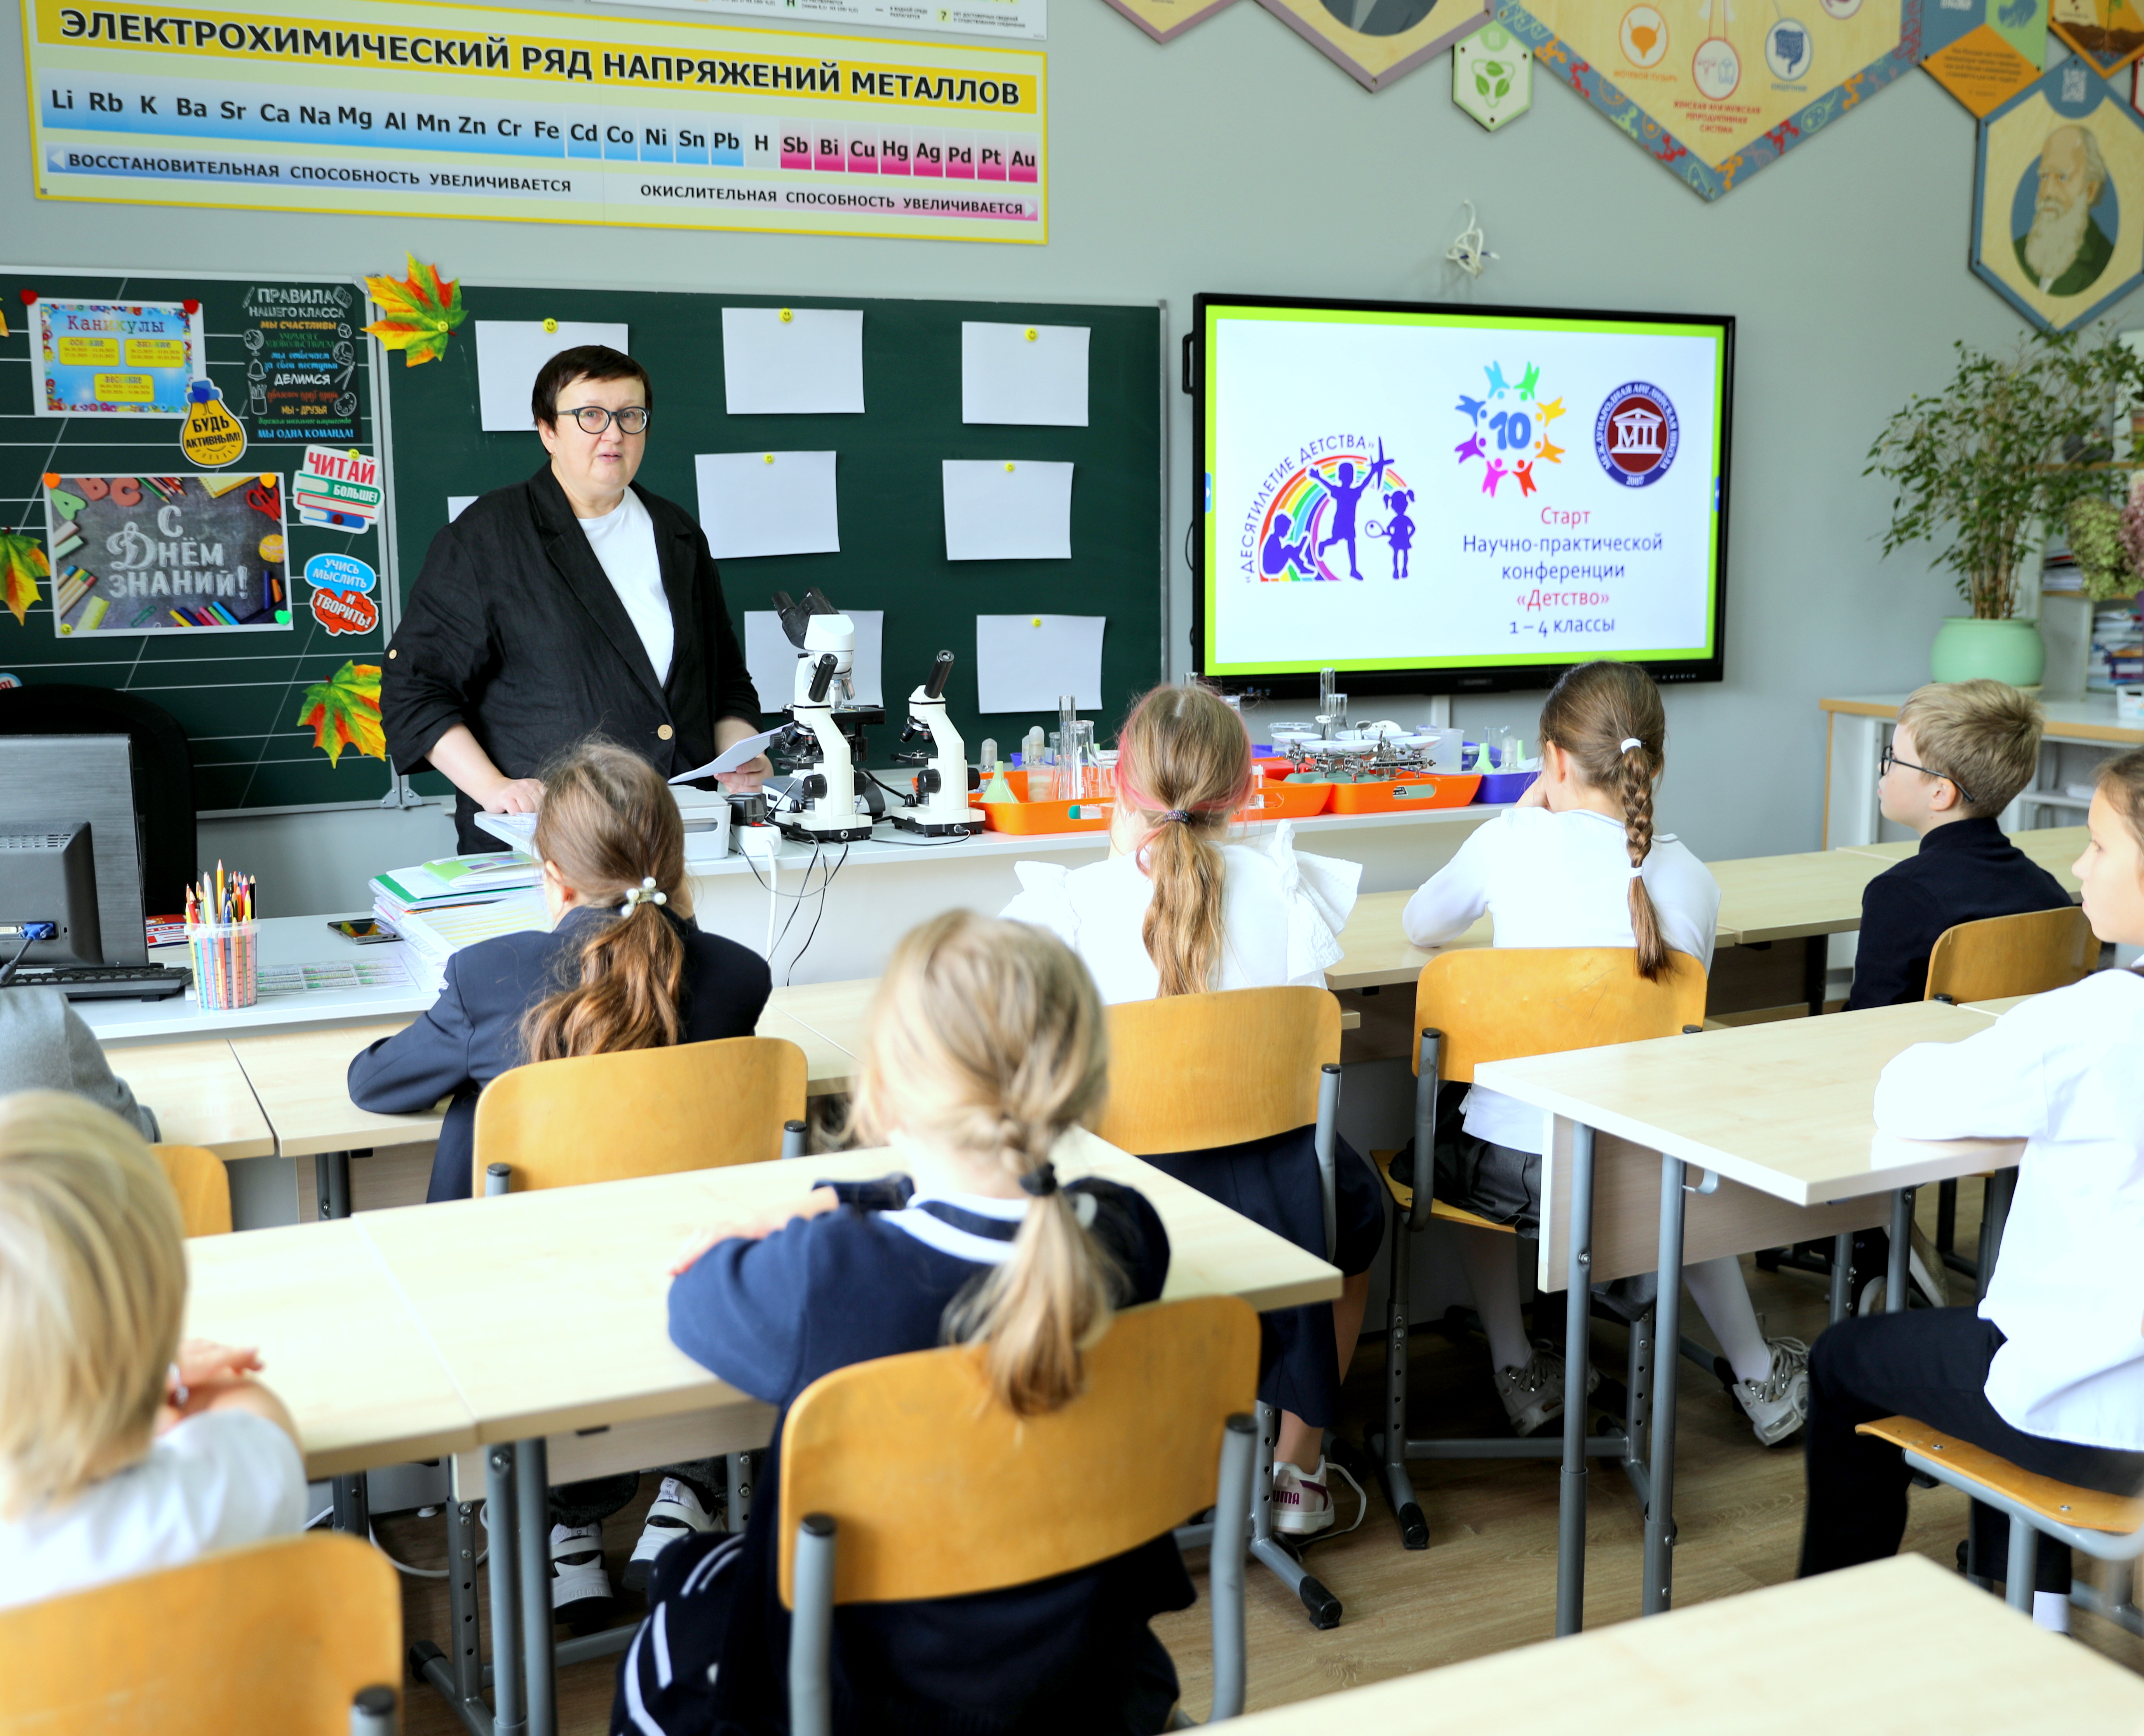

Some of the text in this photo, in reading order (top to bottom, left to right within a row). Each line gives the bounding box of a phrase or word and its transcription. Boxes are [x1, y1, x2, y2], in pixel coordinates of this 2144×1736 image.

[941, 10, 947, 21] ?
[61, 9, 1019, 104] ЭЛЕКТРОХИМИЧЕСКИЙ РЯД НАПРЯЖЕНИЙ МЕТАЛЛОВ
[52, 89, 1035, 167] Li Rb K Ba Sr Ca Na Mg Al Mn Zn Cr Fe Cd Co Ni Sn Pb H Sb Bi Cu Hg Ag Pd Pt Au
[69, 153, 571, 192] ВОССТАНОВИТЕЛЬНАЯ СПОСОБНОСТЬ УВЕЛИЧИВАЕТСЯ
[641, 185, 1022, 214] ОКИСЛИТЕЛЬНАЯ СПОСОБНОСТЬ УВЕЛИЧИВАЕТСЯ
[257, 287, 335, 305] ПРАВИЛА
[249, 306, 345, 318] НАШЕГО КЛАССА
[67, 315, 165, 334] Каникулы
[260, 320, 337, 330] МЫ СЧАСТЛИВЫ
[273, 373, 331, 386] ДЕЛИМСЯ
[281, 405, 294, 415] МЫ
[300, 405, 327, 416] ДРУЗЬЯ
[192, 415, 230, 433] БУДЬ
[1489, 411, 1531, 451] 10
[186, 432, 242, 449] АКТИВНЫМ!
[257, 429, 354, 439] МЫ ОДНА КОМАНДА!
[308, 452, 376, 485] ЧИТАЙ
[1626, 475, 1645, 486] 2007
[333, 484, 378, 503] БОЛЬШЕ!
[157, 505, 184, 538] С
[1541, 507, 1590, 529] Старт
[106, 521, 225, 571] ДНЁМ
[1463, 533, 1662, 557] Научно-практической
[324, 557, 360, 575] УЧИСЬ
[1502, 561, 1625, 584] конференции
[108, 565, 248, 599] ЗНАНИЙ!
[312, 568, 367, 589] МЫСЛИТЬ
[345, 593, 357, 605] И
[1516, 589, 1609, 612] «Детство»
[316, 593, 373, 629] ТВОРИТЬ!
[1510, 621, 1518, 634] 1
[1538, 620, 1548, 638] 4
[1554, 619, 1615, 633] классы
[665, 1478, 674, 1501] GESS
[1273, 1489, 1300, 1505] UMA
[569, 1587, 603, 1599] GUESS
